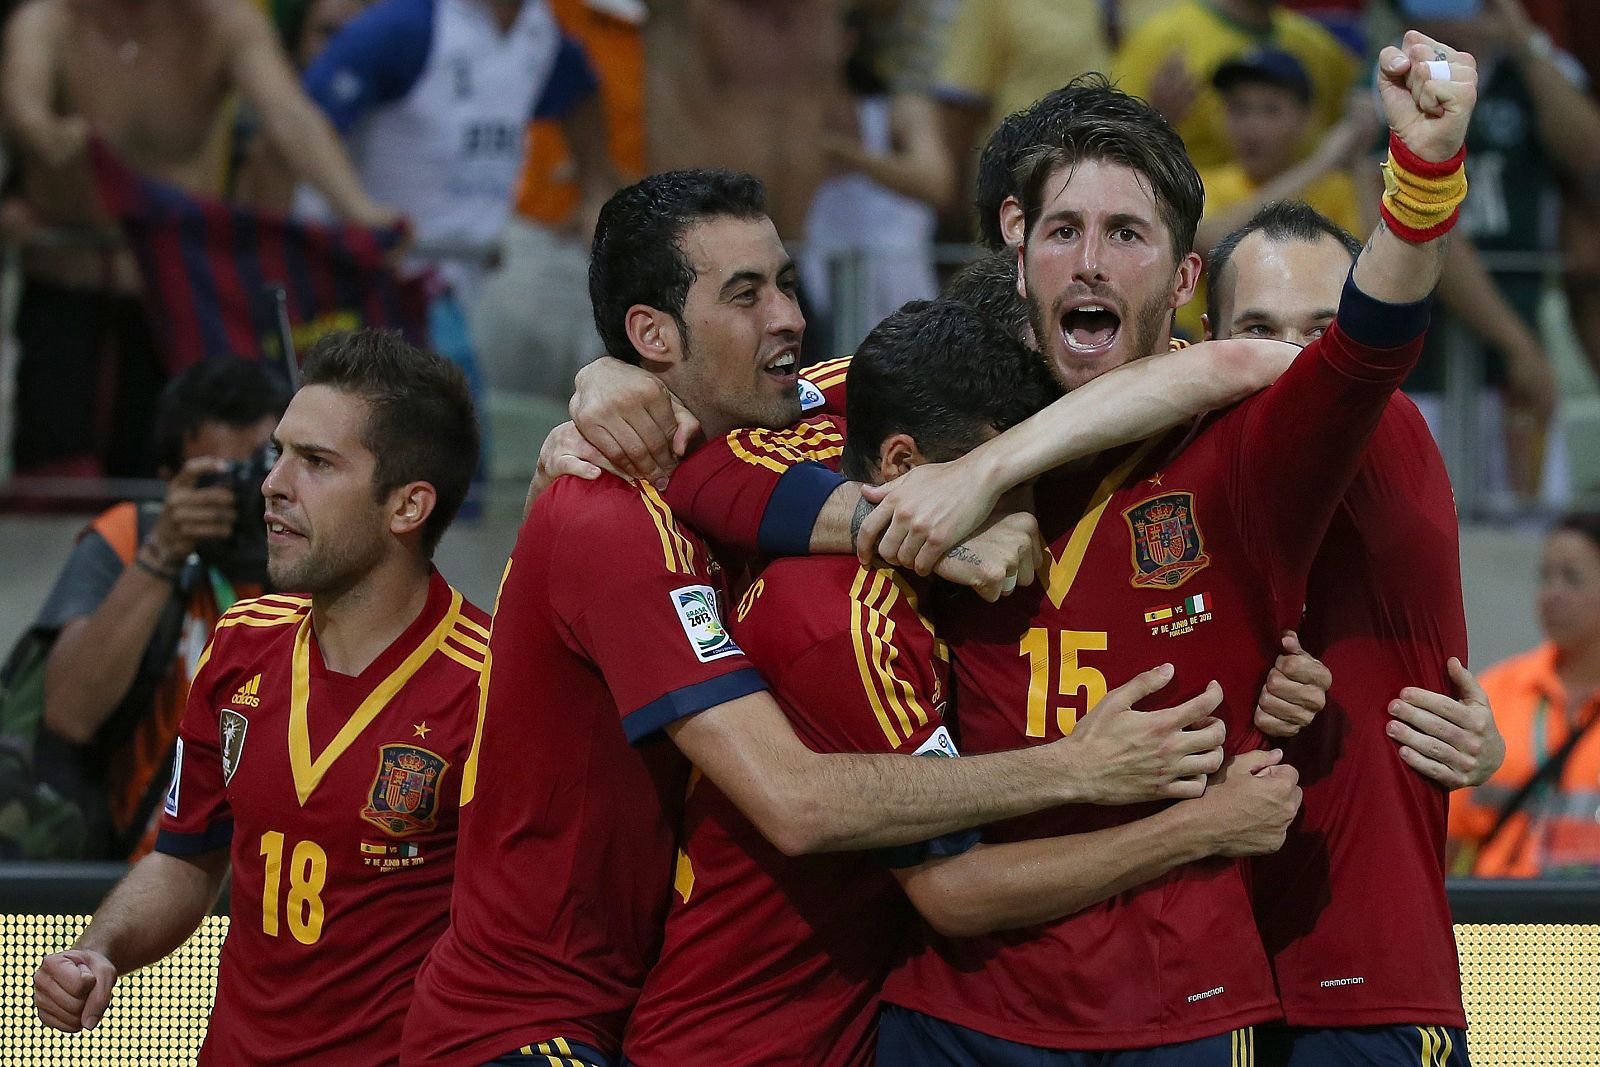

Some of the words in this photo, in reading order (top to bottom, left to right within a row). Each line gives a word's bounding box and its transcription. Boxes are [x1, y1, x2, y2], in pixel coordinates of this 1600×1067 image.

[1175, 605, 1184, 614] VS
[688, 612, 712, 628] 2013
[1160, 624, 1170, 634] DE
[1171, 619, 1188, 631] JUNIO
[1189, 615, 1198, 625] DE
[1019, 627, 1108, 738] 15
[231, 691, 260, 708] adidas
[259, 830, 327, 945] 18
